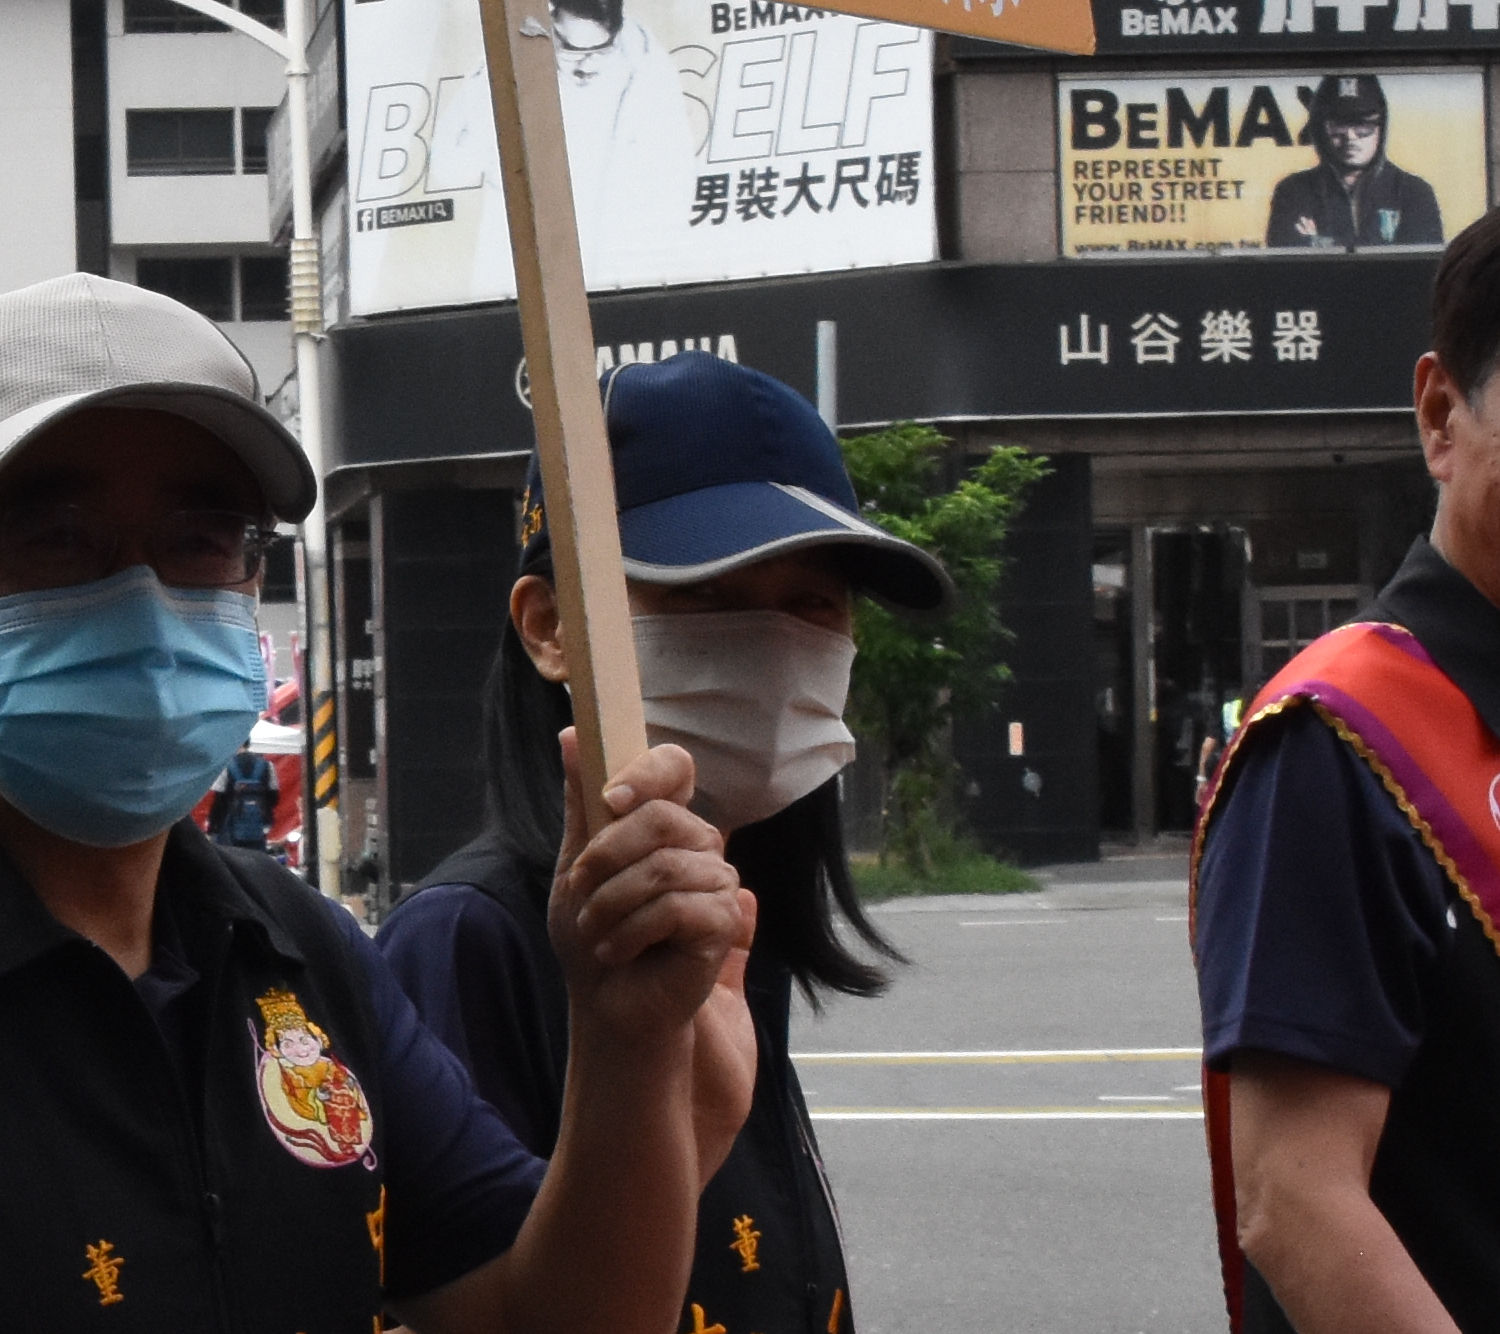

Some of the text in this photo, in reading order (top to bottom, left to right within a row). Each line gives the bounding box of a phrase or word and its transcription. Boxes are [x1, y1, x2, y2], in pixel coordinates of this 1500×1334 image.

[1073, 158, 1222, 180] REPRESENT
[689, 151, 922, 227] 男裝大尺碼
[1073, 180, 1245, 202] YOUR STREET
[1075, 204, 1187, 225] FRIEND!!
[1059, 309, 1324, 368] 山谷樂器
